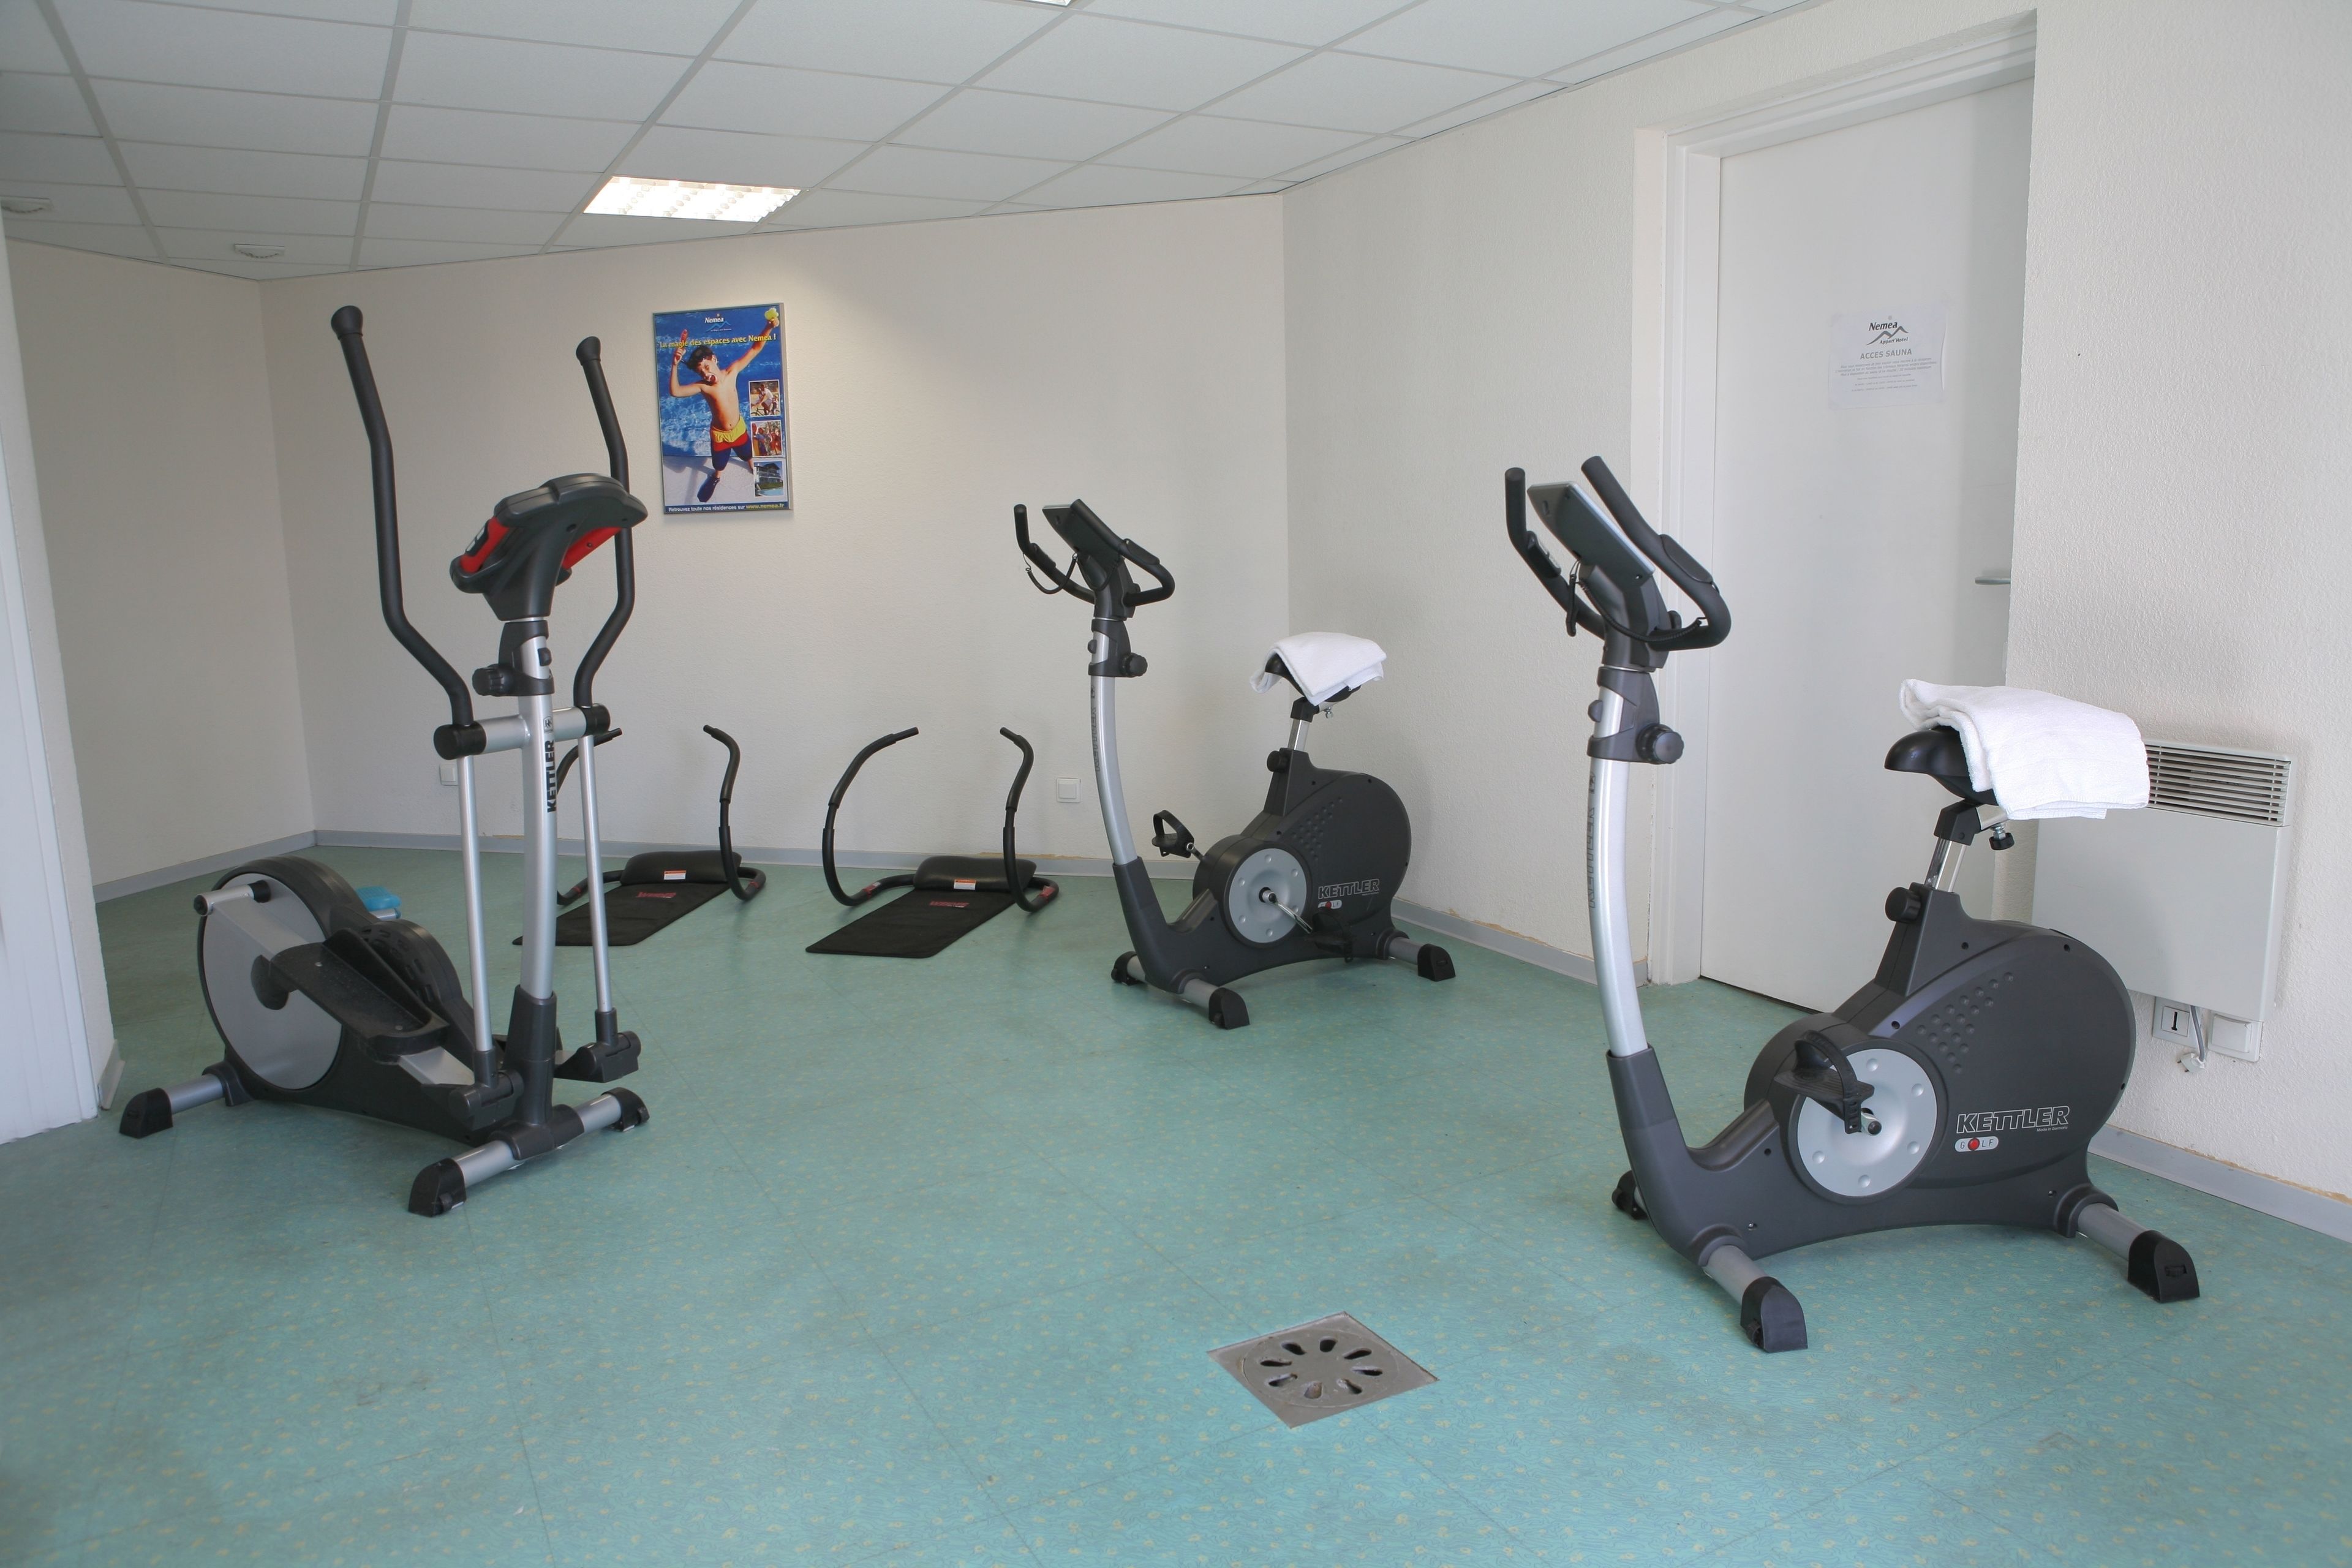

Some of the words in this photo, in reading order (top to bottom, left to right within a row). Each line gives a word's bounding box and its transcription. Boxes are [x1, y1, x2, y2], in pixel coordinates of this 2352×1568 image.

[669, 340, 688, 349] magie
[703, 337, 730, 346] espaces
[1860, 351, 1884, 360] ACCES
[1886, 348, 1913, 358] SAUNA
[544, 740, 557, 813] KETTLER
[1318, 878, 1380, 900] KETTLER
[1956, 1105, 2070, 1134] KETTLER
